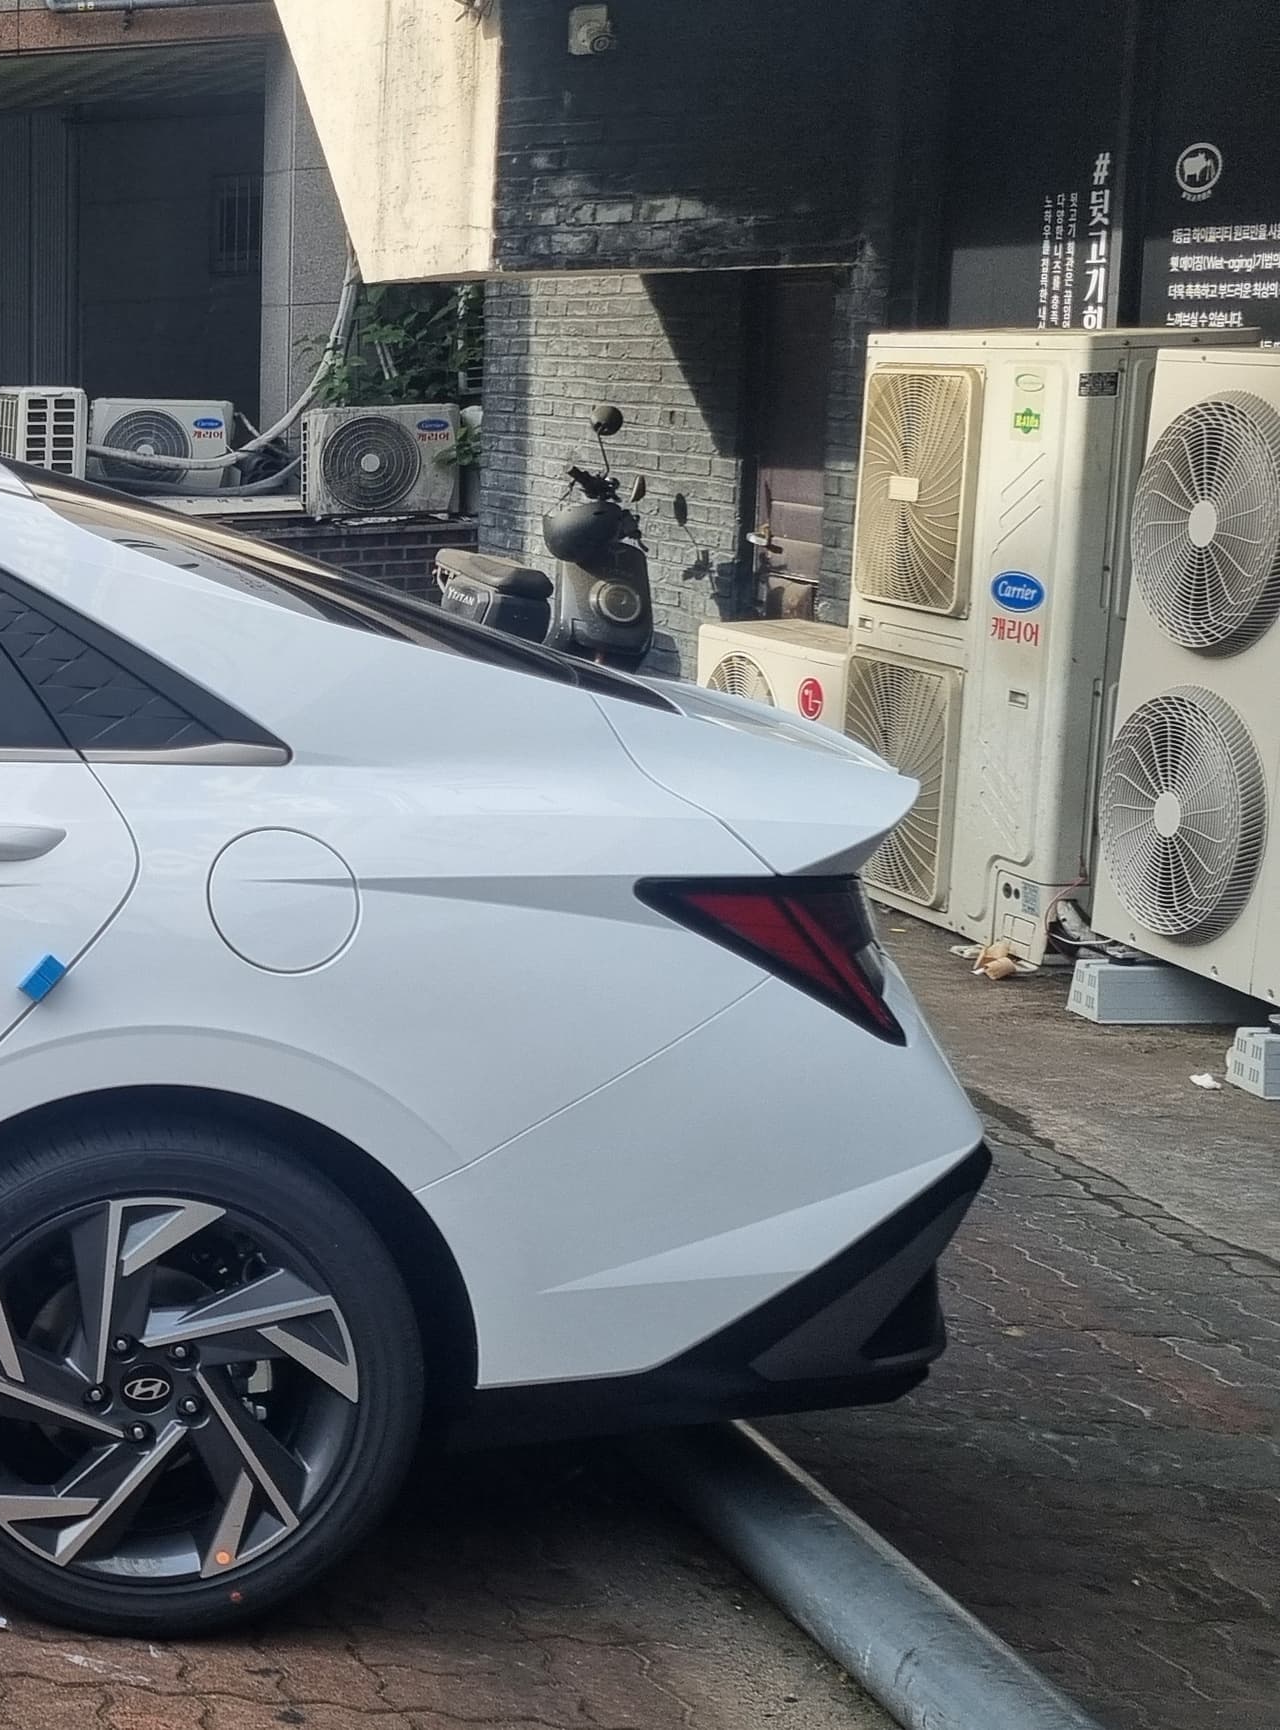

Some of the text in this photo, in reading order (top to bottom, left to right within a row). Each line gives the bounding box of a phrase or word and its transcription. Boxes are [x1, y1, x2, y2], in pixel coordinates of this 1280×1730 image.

[193, 430, 223, 440] 캐리어
[417, 431, 450, 442] 캐리어
[998, 580, 1038, 601] Carrier
[991, 616, 1039, 647] 캐리어
